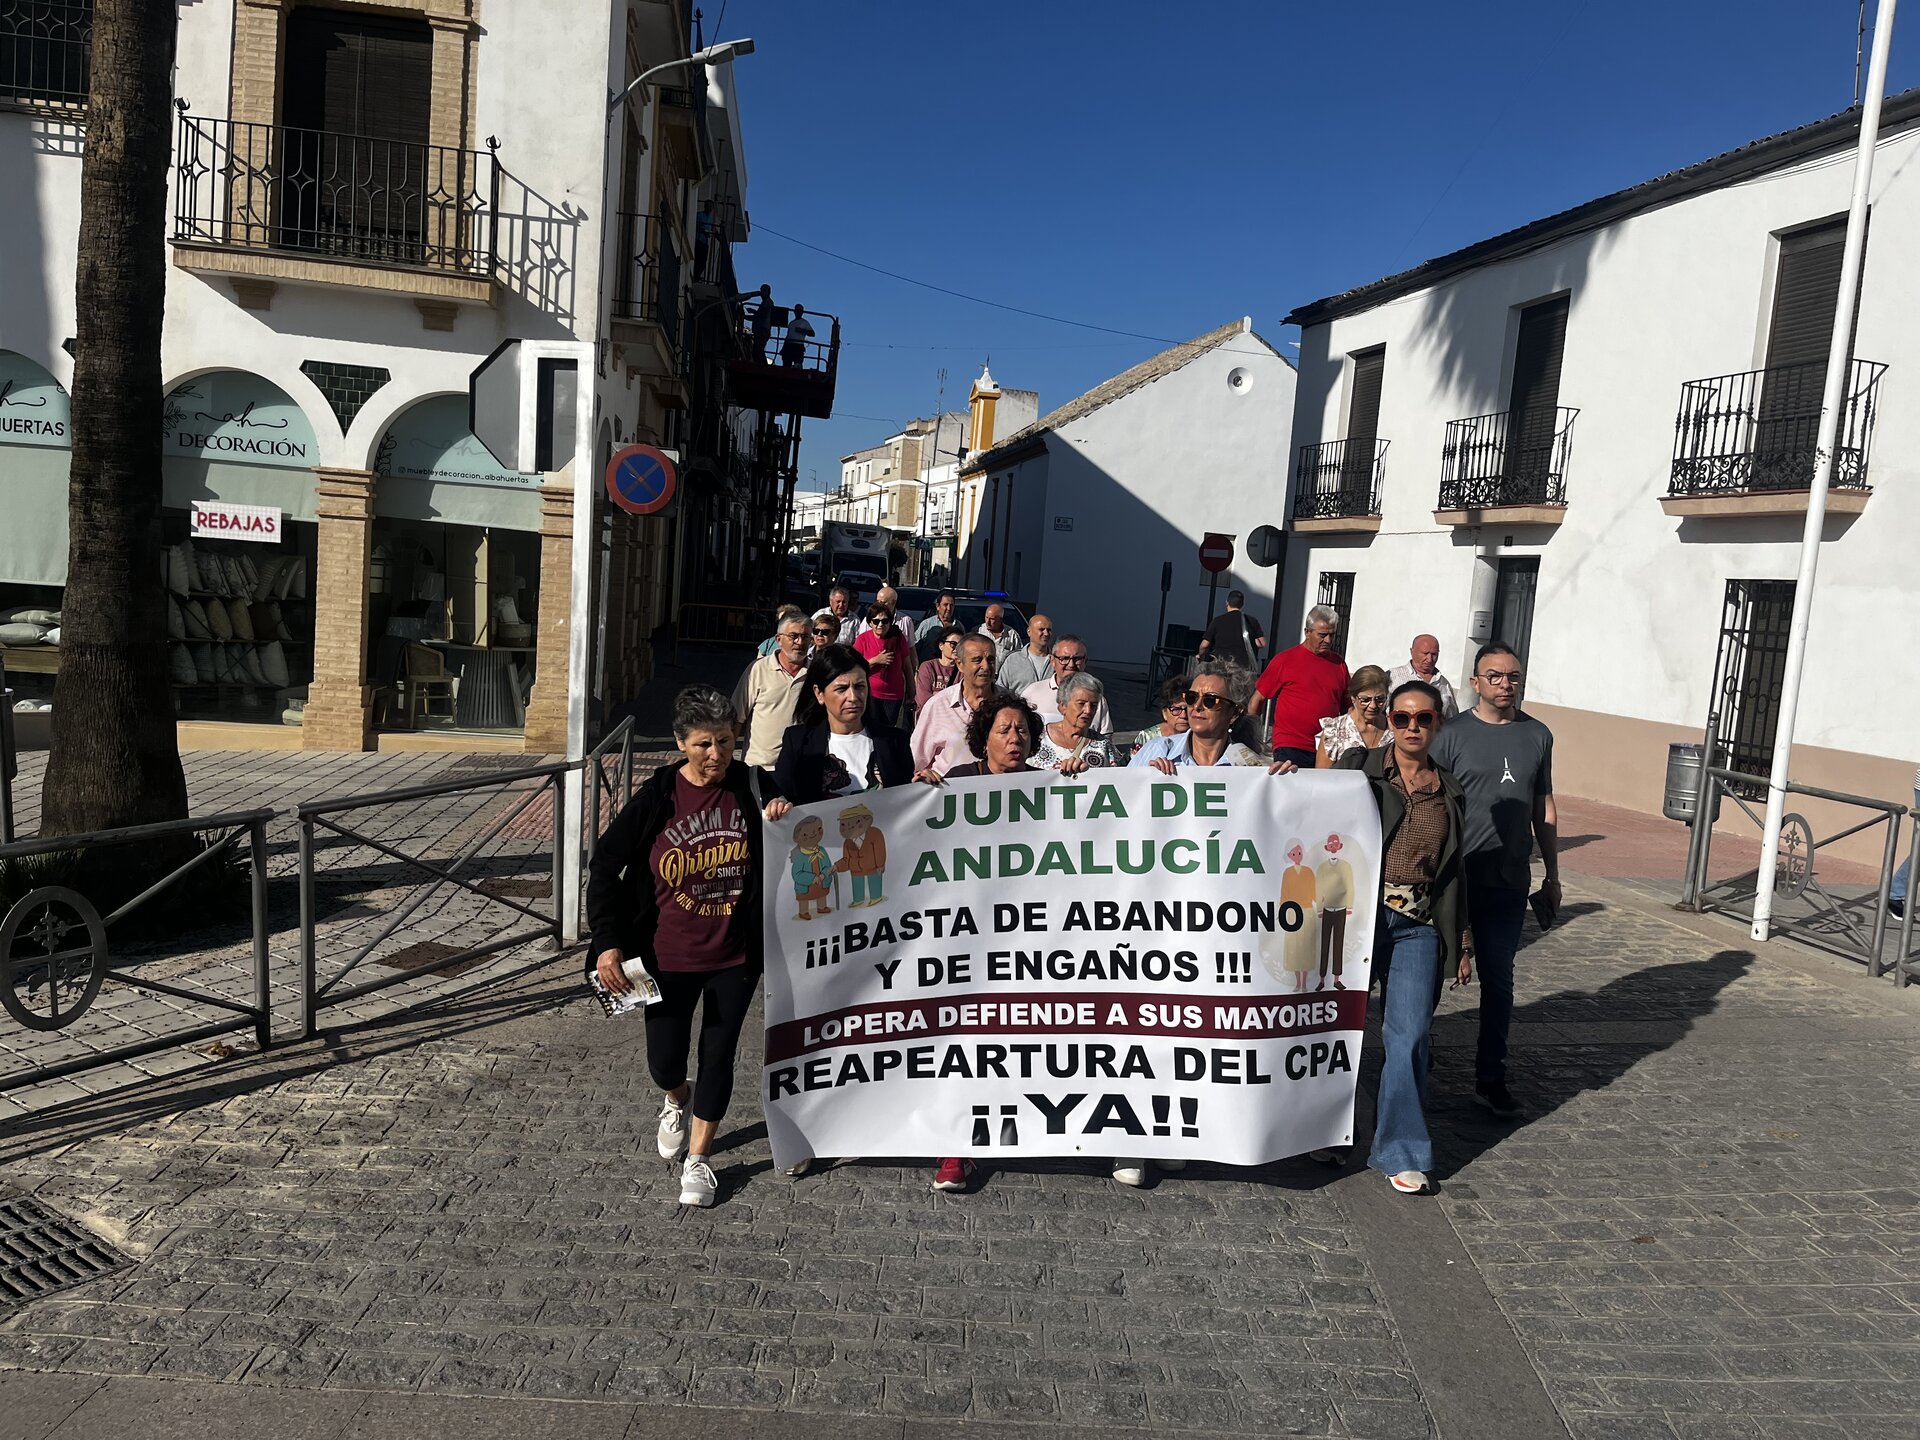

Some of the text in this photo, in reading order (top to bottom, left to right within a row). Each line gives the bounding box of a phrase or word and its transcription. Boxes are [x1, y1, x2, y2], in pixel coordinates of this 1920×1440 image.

[0, 417, 65, 436] UERTAS
[178, 432, 306, 458] DECORACIÓN
[197, 511, 275, 533] REBAJAS
[664, 807, 723, 846] DENIM
[925, 782, 1228, 829] JUNTA DE
[717, 866, 741, 878] SINCE
[908, 830, 1266, 886] ANDALUCÍA
[805, 901, 1304, 969] ¡¡¡BASTA DE ABANDONO
[874, 942, 1252, 990] Y DE ENGAÑOS !!!
[804, 1000, 1338, 1047] LOPERA DEFIENDE A SUS MAYORES
[769, 1040, 1352, 1102] REAPEARTURA DEL CPA
[971, 1093, 1200, 1146] ¡¡YA!!
